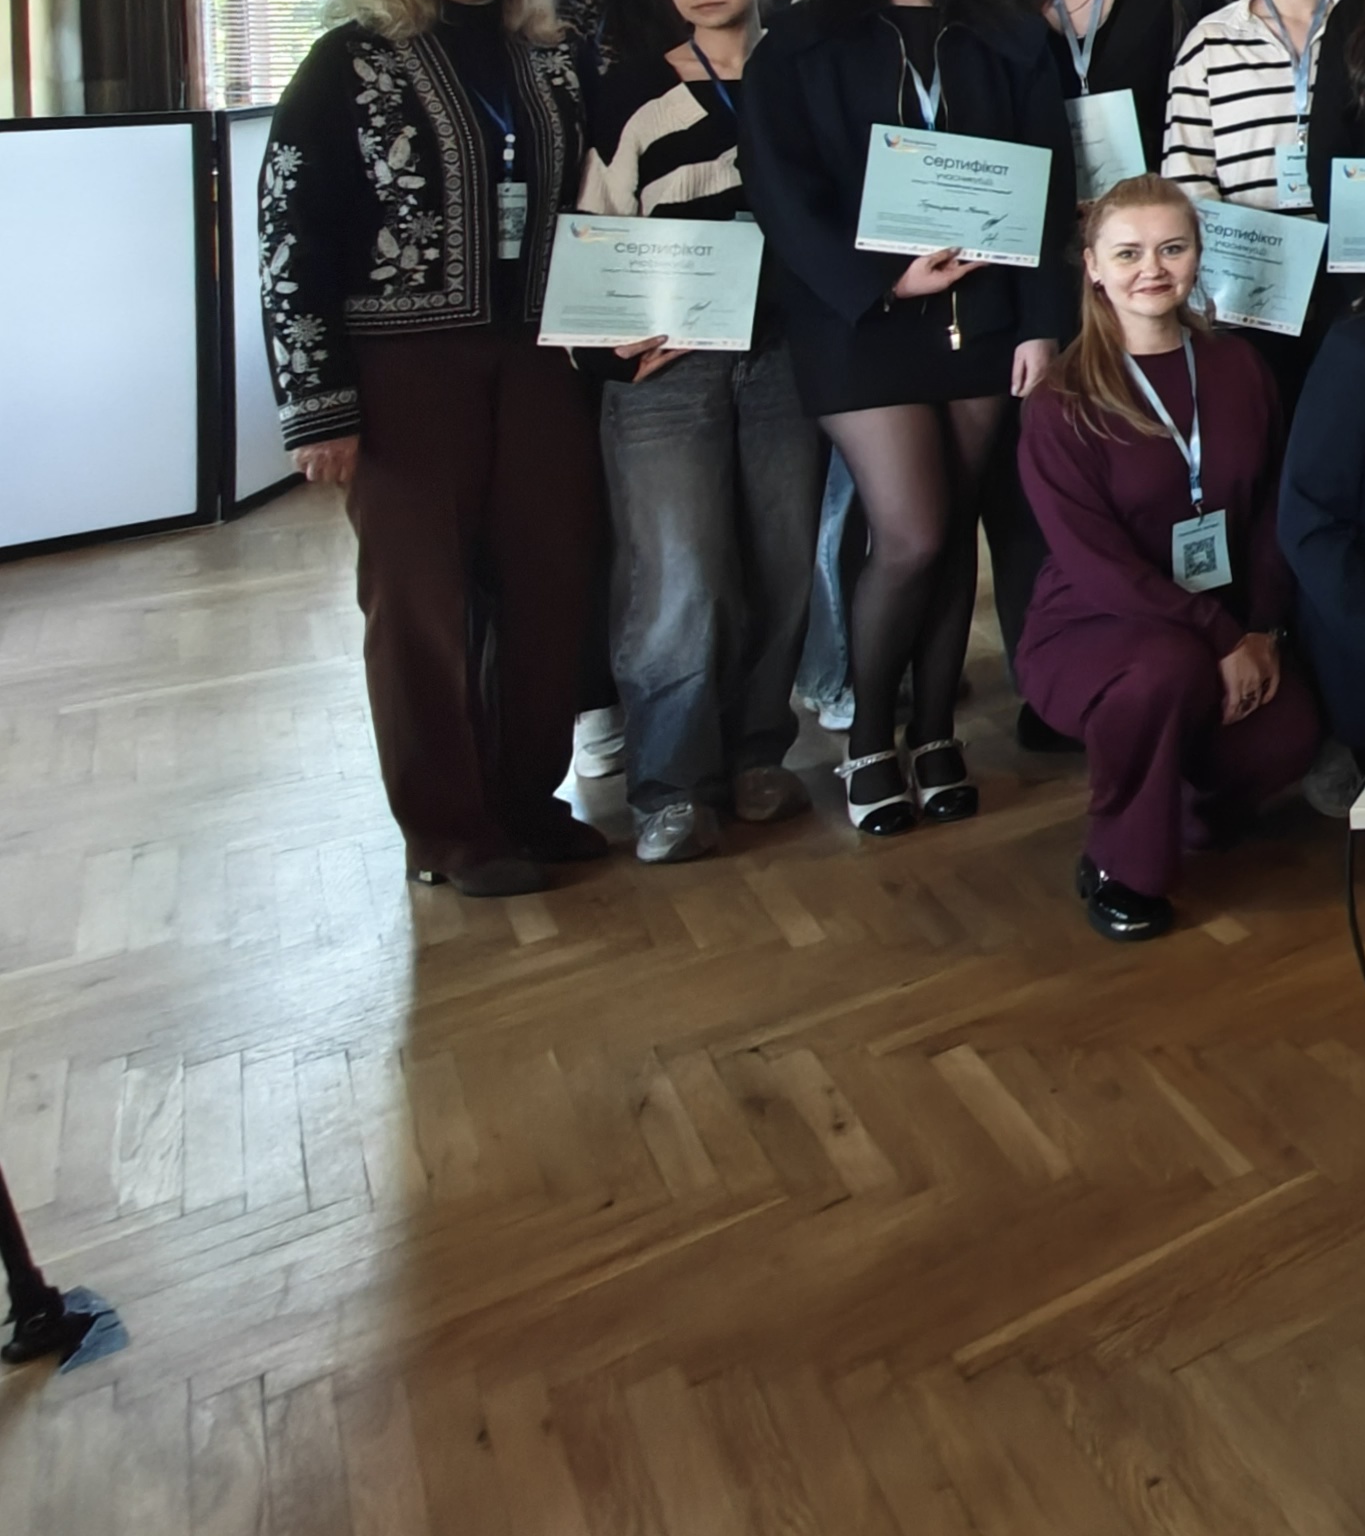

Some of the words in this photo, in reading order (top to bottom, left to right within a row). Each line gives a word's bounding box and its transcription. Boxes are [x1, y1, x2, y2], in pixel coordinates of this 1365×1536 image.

[922, 154, 1010, 176] сертифікат
[1204, 222, 1283, 246] сертифікат
[614, 240, 714, 257] сертифікат
